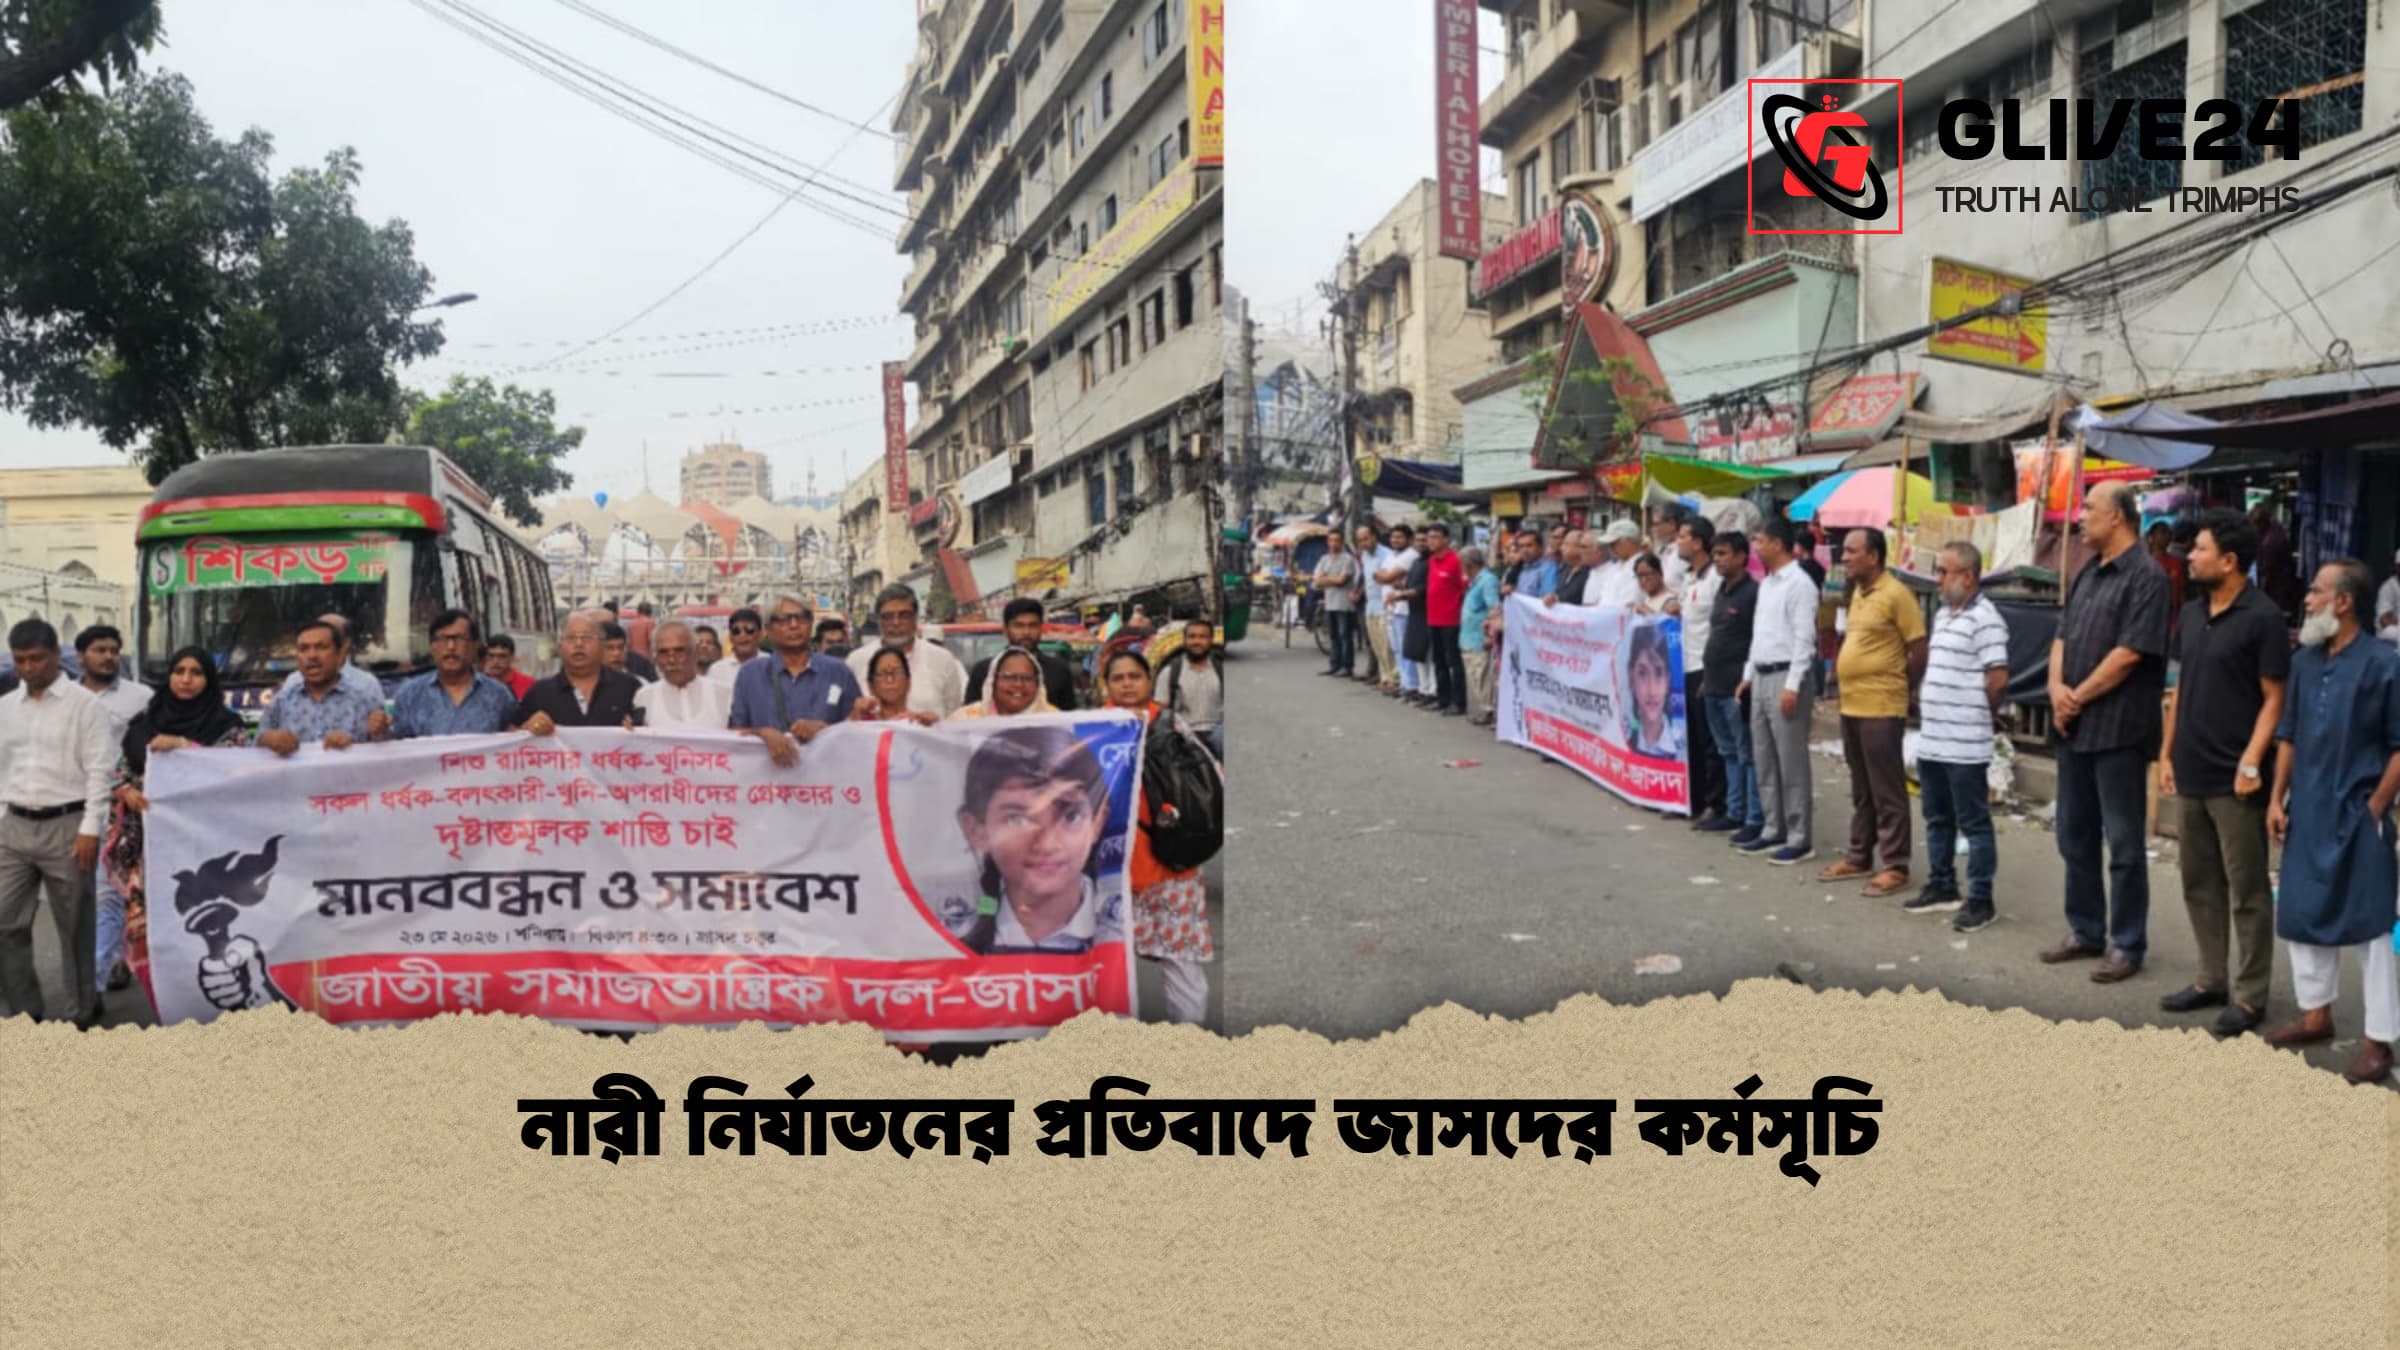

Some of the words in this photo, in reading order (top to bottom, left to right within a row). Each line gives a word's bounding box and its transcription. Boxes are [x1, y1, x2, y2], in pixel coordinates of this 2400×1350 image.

[1443, 0, 1471, 128] MPERIAL
[180, 535, 357, 584] শিকড়
[438, 750, 487, 773] শিশু
[496, 744, 582, 772] রামিসার
[591, 744, 733, 775] ধর্ষক-খুনিসহ
[308, 791, 370, 815] সকল
[841, 787, 863, 805] ও
[434, 815, 592, 861] দৃষ্টান্তমূলক
[601, 811, 671, 848] শাস্তি
[680, 811, 740, 849] চাই
[312, 869, 587, 918] মানববন্ধন
[599, 870, 640, 910] ও
[651, 871, 861, 915] সমাবেশ
[316, 957, 492, 1008] জাতীয়
[502, 960, 829, 1011] সমাজতান্ত্রিক
